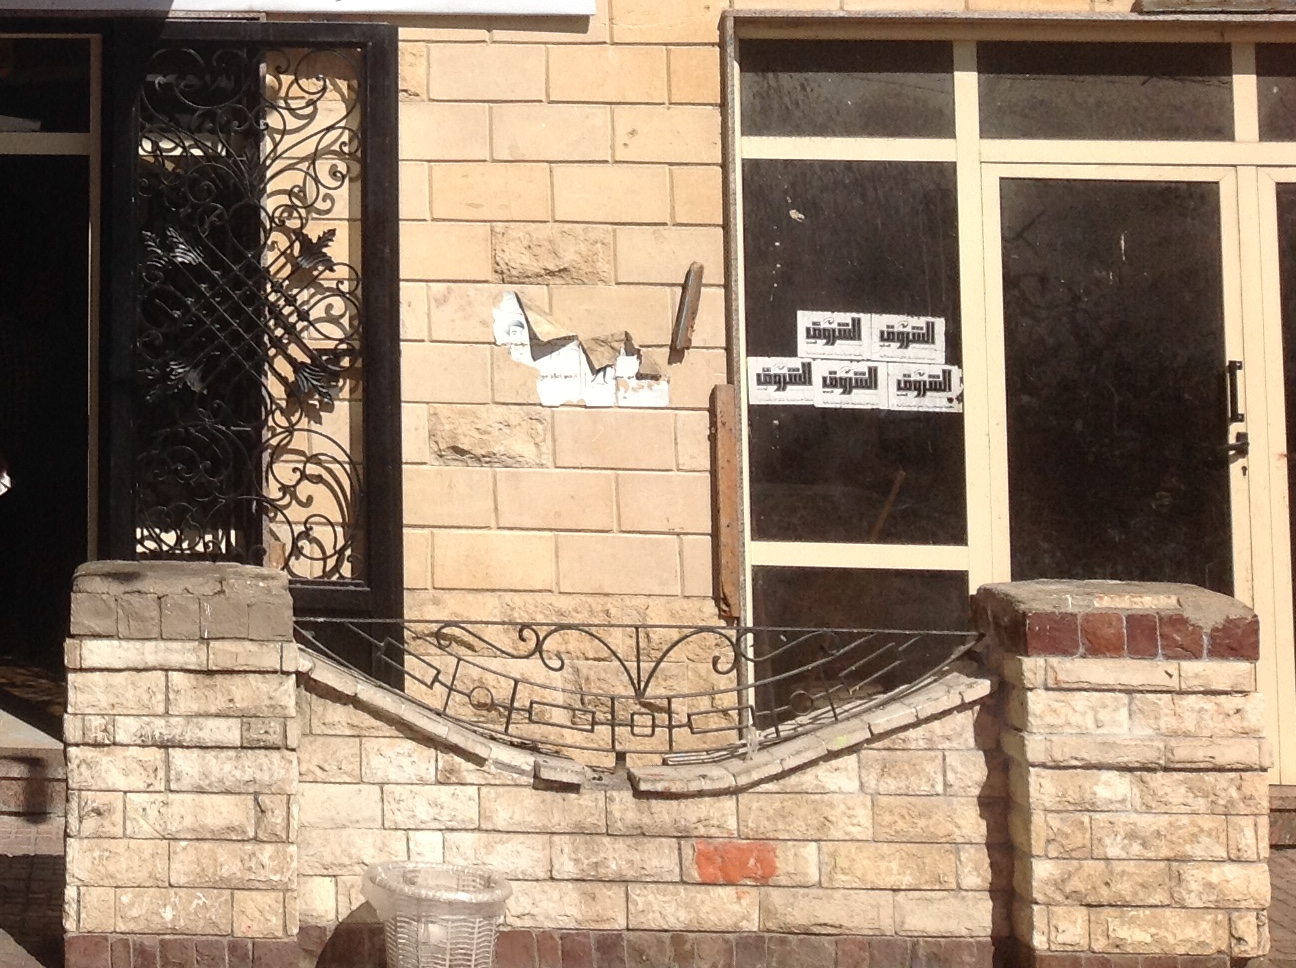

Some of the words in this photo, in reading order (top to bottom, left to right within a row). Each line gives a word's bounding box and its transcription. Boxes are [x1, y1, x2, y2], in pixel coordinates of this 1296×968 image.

[805, 317, 862, 346] الشروق
[879, 321, 936, 350] الشروق
[756, 361, 813, 392] الشروق
[822, 365, 879, 395] الشروق
[896, 369, 952, 399] الشروق
